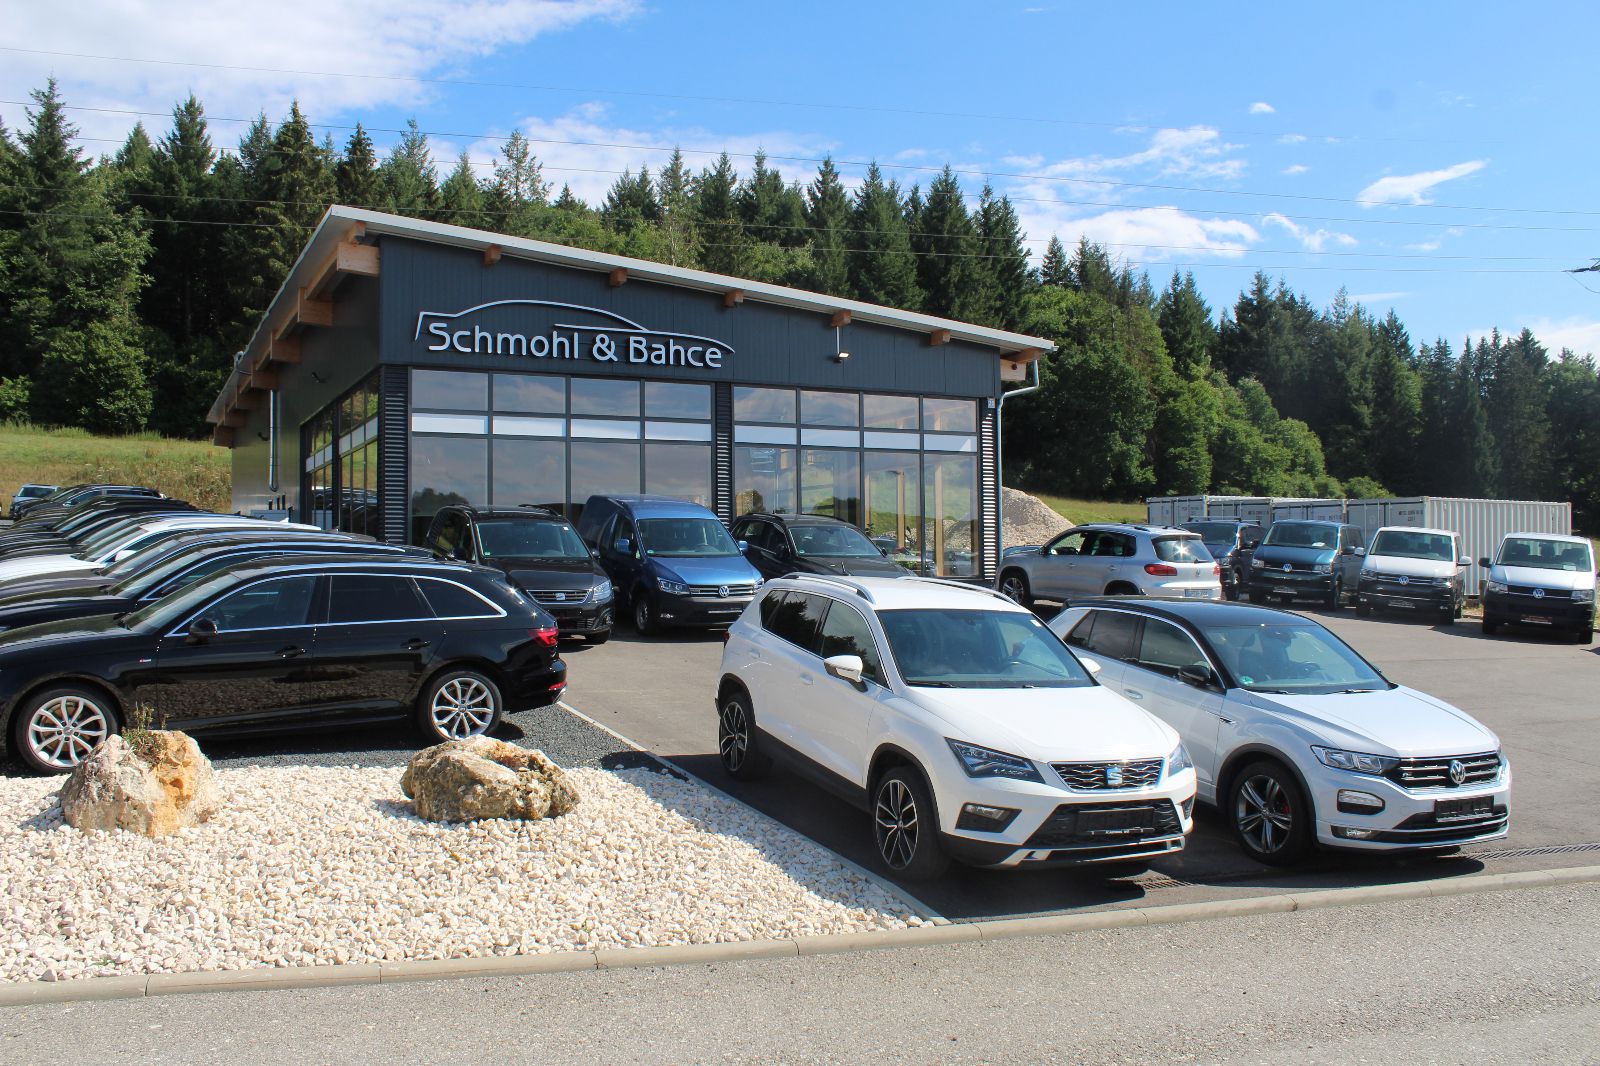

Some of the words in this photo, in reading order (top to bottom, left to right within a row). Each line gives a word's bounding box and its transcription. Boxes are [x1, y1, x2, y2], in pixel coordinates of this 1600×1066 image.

[428, 322, 579, 359] Schmohl
[592, 333, 618, 362] &
[629, 336, 722, 368] Bahce
